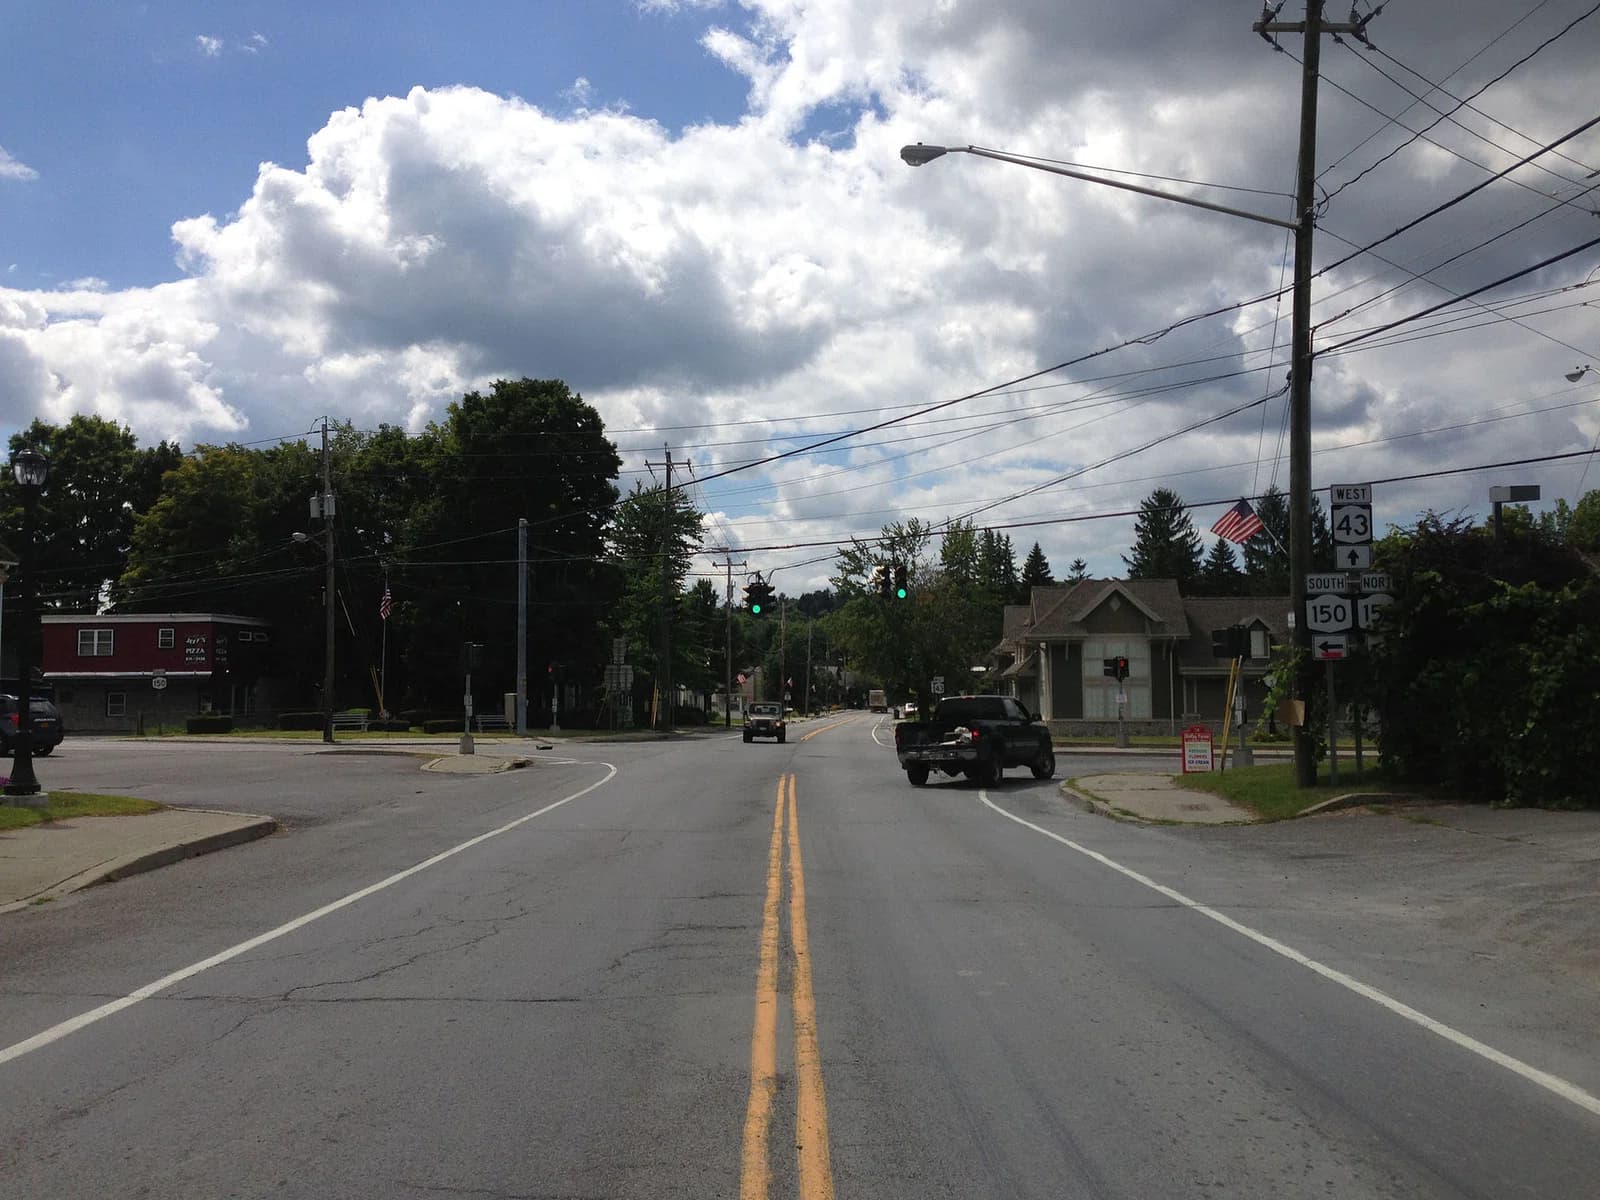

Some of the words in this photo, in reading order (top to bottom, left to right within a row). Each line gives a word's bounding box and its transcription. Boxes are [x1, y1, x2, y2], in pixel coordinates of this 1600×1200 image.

[1336, 488, 1367, 500] WEST
[1336, 514, 1369, 536] 43
[1308, 577, 1345, 590] SOUTH
[1312, 604, 1347, 623] 150
[1363, 604, 1385, 623] 15
[153, 679, 166, 687] 150
